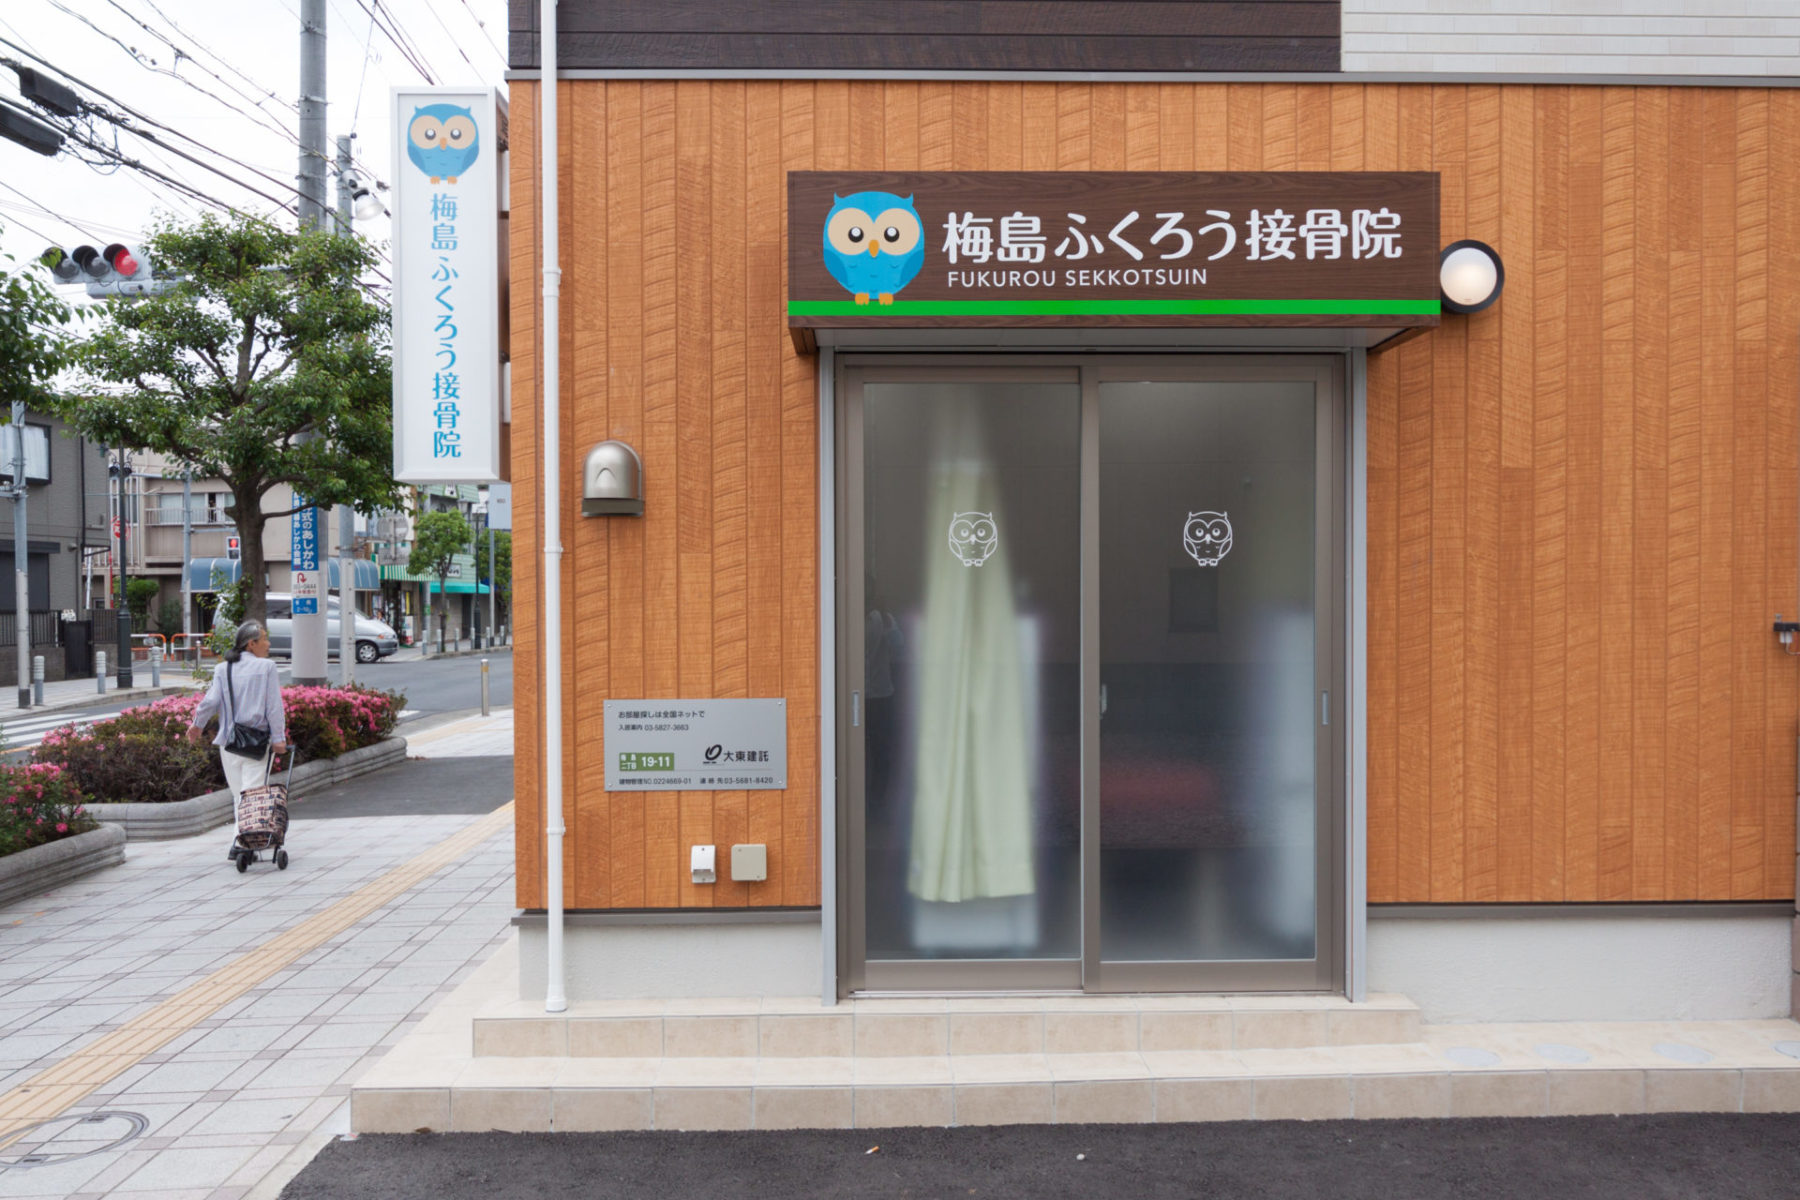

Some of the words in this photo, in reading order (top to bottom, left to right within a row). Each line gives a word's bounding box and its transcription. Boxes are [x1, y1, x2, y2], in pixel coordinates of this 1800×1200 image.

[942, 208, 1402, 264] 梅島ふくろう接骨院
[947, 270, 1057, 289] FUKUROU
[1065, 268, 1208, 288] SEKKOTSUIN
[431, 193, 461, 459] 梅島ふくろう接骨院
[642, 756, 670, 768] 19-11
[724, 750, 769, 762] 大東建託
